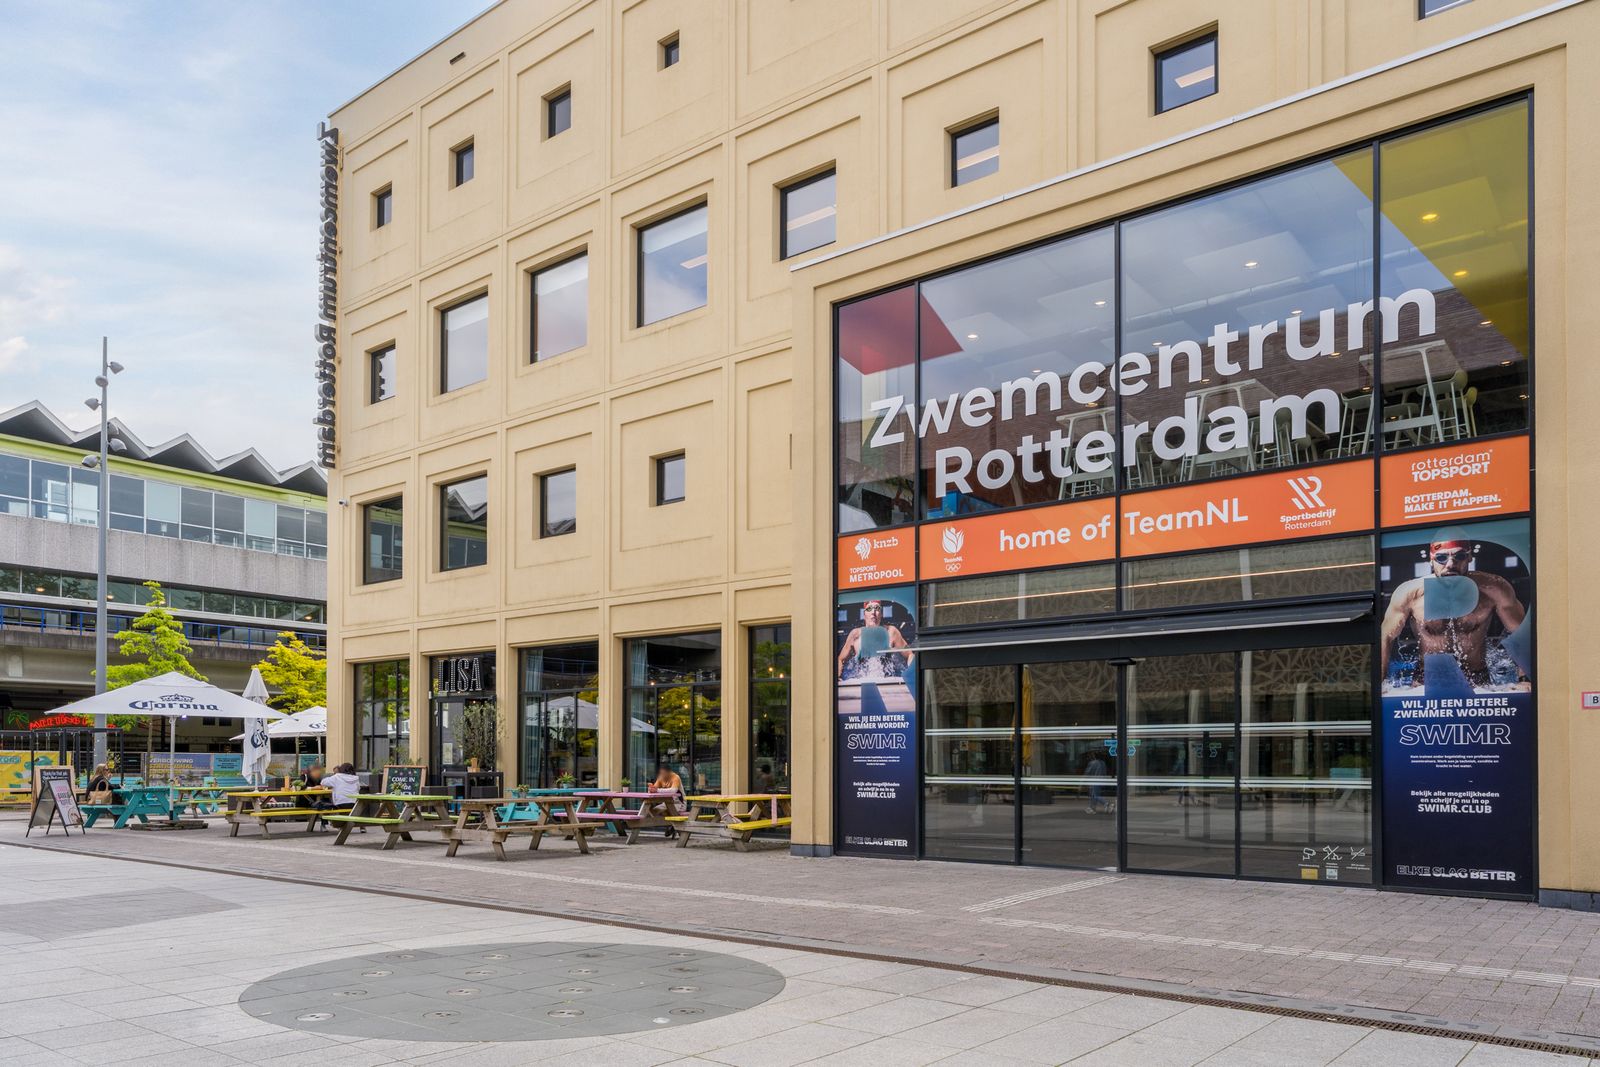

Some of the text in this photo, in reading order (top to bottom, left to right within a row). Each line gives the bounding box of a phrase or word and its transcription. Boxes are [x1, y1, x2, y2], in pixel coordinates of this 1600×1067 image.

[870, 288, 1436, 448] Zwemcentrum
[935, 388, 1341, 498] Rotterdam
[1411, 451, 1490, 471] rotterdam
[1412, 461, 1490, 483] TOPSPORT
[1404, 488, 1472, 505] ROTTERDAM.
[1404, 494, 1502, 514] MAKE IT HAPPEN.
[1280, 508, 1337, 524] Sportbedrijf
[1000, 497, 1249, 552] home of TeamNL
[1285, 518, 1331, 531] Rotterdam
[873, 536, 899, 549] knzb
[849, 564, 877, 574] TOPSPORT
[849, 568, 904, 583] METROPOOL
[438, 657, 482, 693] LISA
[129, 700, 220, 711] Corona
[1401, 697, 1508, 710] WIL JIJ EEN BETERE
[1393, 707, 1518, 719] ZWEMMER WORDEN?
[844, 721, 909, 730] ZWEMMER WORDEN?
[847, 733, 906, 749] SWIMR
[1400, 723, 1511, 745] SWIMR
[857, 791, 896, 799] SWIMR.CLUB
[1417, 803, 1493, 814] SWIMR.CLUB
[884, 838, 908, 847] BETER
[1396, 865, 1517, 881] ELKE SLAG BETER
